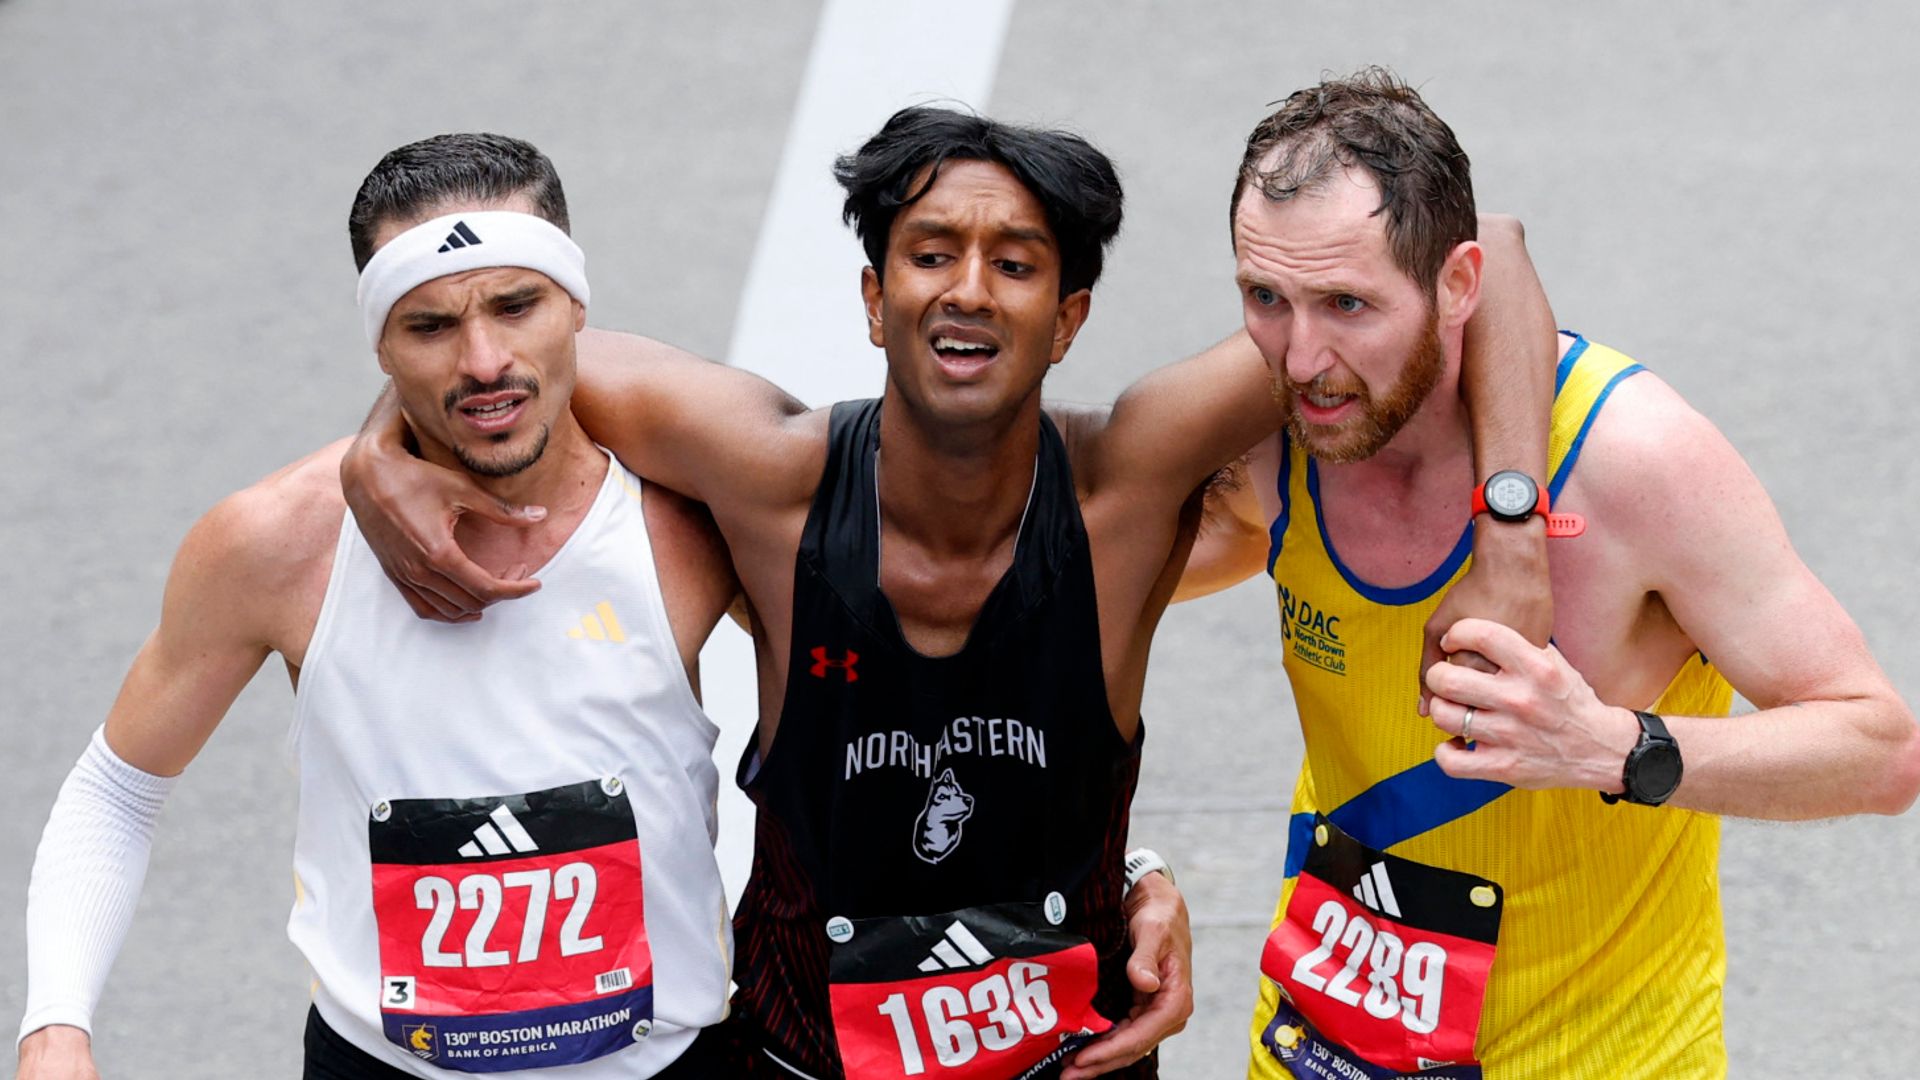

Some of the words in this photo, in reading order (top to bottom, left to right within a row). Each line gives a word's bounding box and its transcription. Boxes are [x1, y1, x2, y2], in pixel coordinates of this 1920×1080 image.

[1294, 641, 1321, 664] Athletic
[1324, 656, 1346, 671] Club
[1295, 627, 1317, 647] North
[1319, 639, 1344, 657] Down
[845, 716, 1047, 781] NORHASTERN
[413, 862, 604, 968] 2272
[1290, 900, 1447, 1034] 2289
[389, 981, 408, 1004] 3
[444, 1031, 477, 1046] 130TH
[479, 1027, 542, 1045] BOSTON
[547, 1008, 631, 1038] MARATHON
[877, 962, 1058, 1076] 1636
[447, 1049, 480, 1058] BANK
[484, 1048, 499, 1058] OF
[502, 1041, 557, 1056] AMERICA
[1305, 1058, 1327, 1077] BANK
